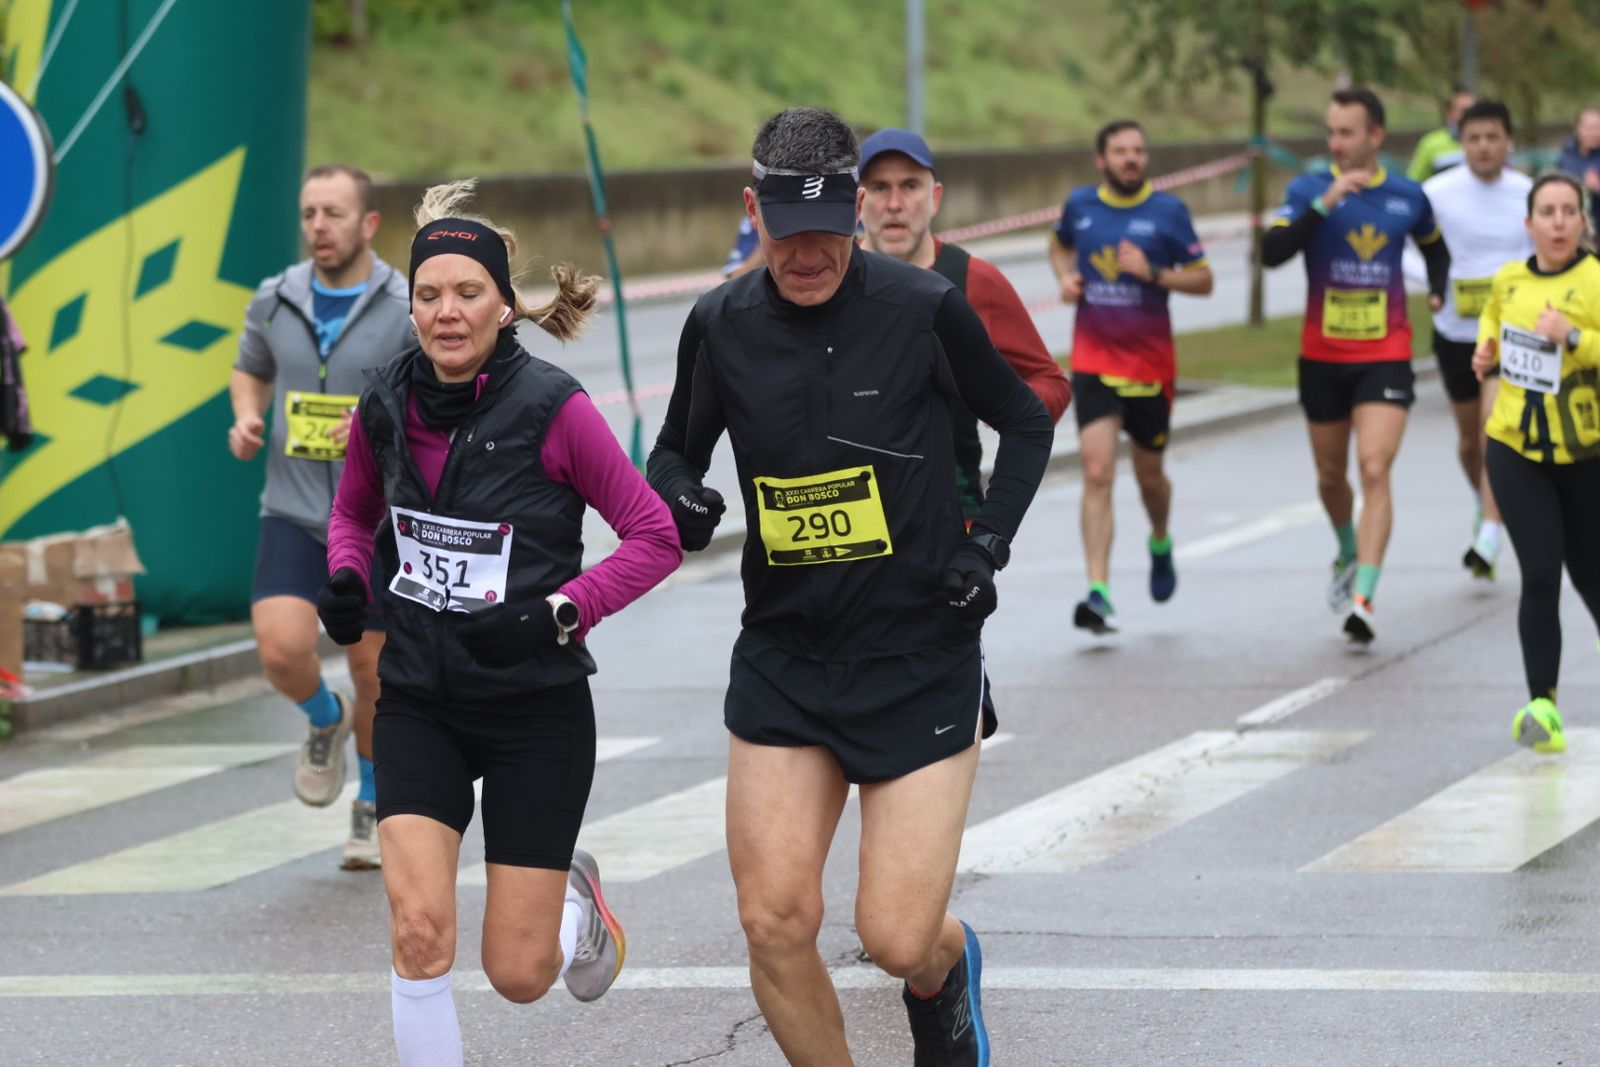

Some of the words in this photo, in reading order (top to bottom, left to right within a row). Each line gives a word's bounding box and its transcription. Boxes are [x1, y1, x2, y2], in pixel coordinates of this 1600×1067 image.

[1507, 350, 1543, 372] 410
[785, 489, 799, 497] XXXI
[800, 486, 827, 495] CARRERA
[827, 480, 856, 490] POPULAR
[786, 494, 807, 504] DON
[808, 489, 840, 501] BOSCO
[690, 503, 709, 515] run
[436, 526, 462, 537] CARRERA
[462, 528, 492, 539] POPULAR
[786, 509, 852, 542] 290
[421, 530, 441, 541] DON
[442, 535, 473, 546] BOSCO
[419, 549, 471, 588] 351
